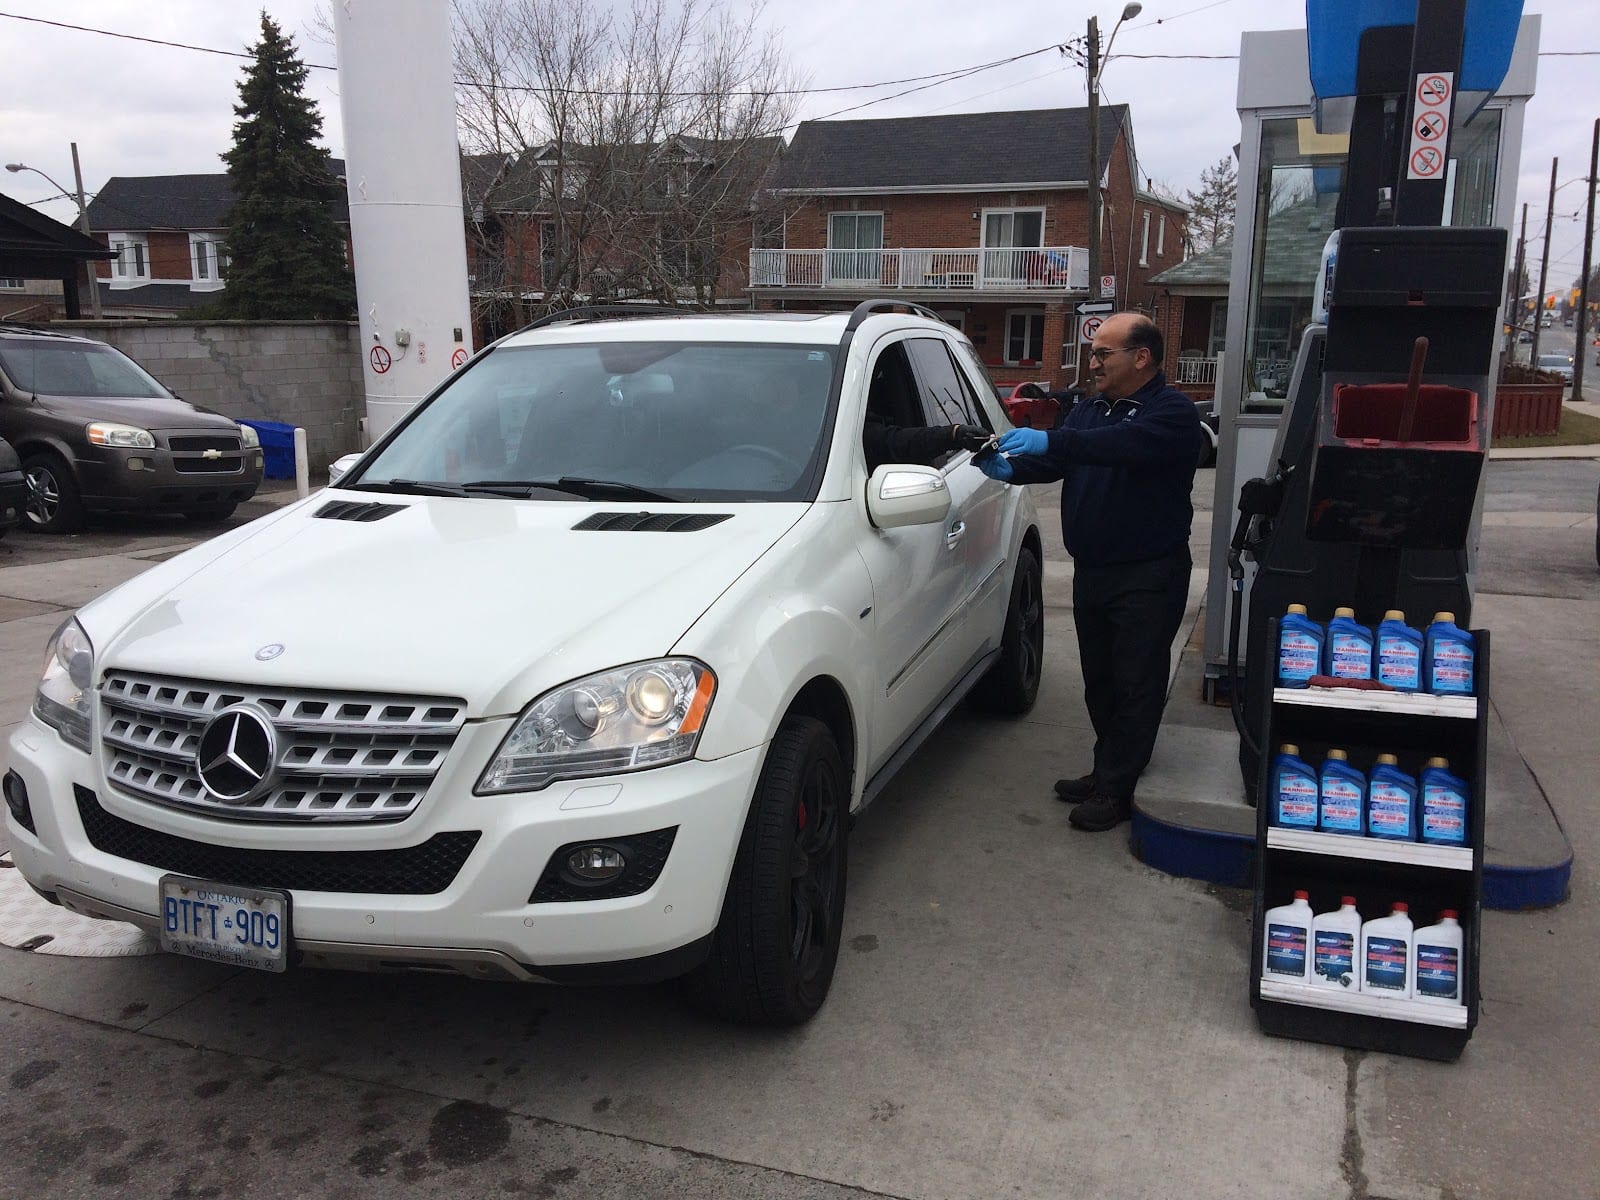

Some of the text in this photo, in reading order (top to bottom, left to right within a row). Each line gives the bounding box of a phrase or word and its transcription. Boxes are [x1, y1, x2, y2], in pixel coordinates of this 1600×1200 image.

[197, 890, 247, 905] ONTARIO
[165, 896, 279, 949] BTFT 909
[186, 944, 259, 968] Mercedes-Benz
